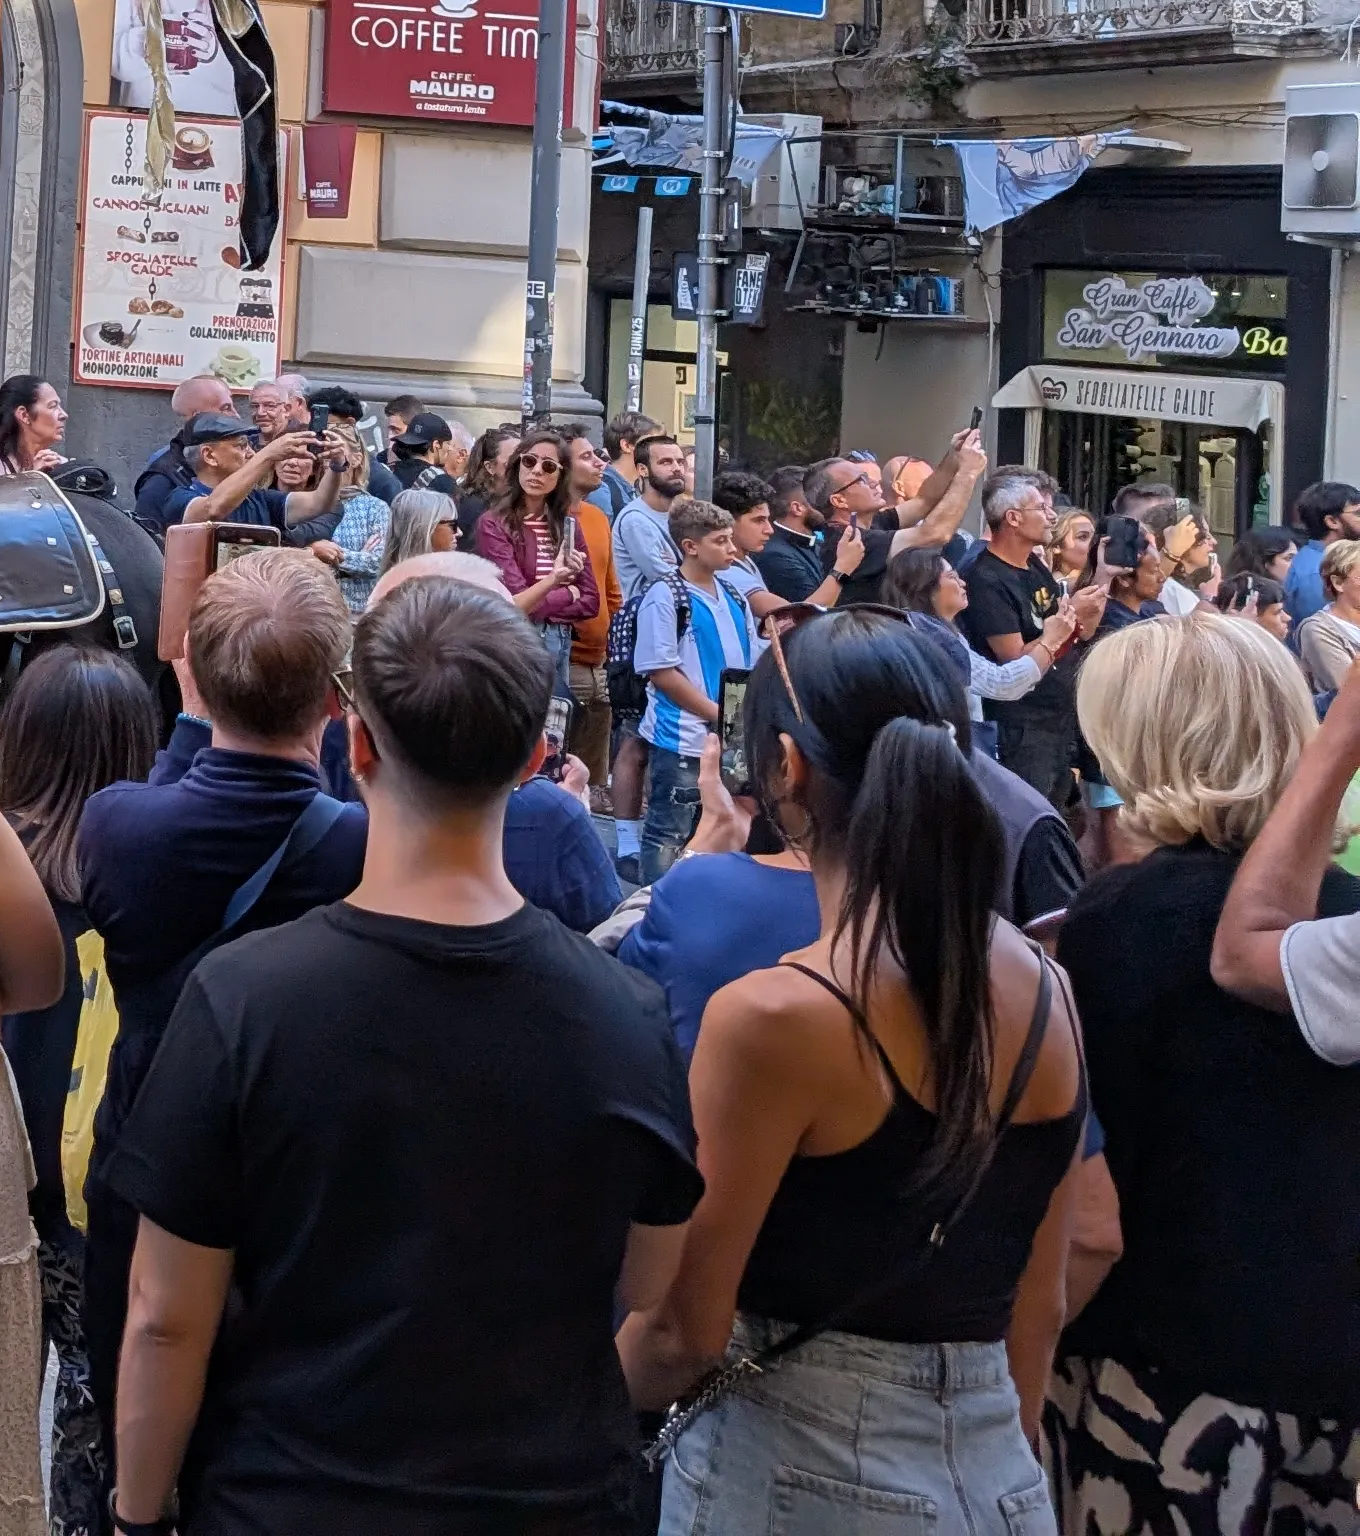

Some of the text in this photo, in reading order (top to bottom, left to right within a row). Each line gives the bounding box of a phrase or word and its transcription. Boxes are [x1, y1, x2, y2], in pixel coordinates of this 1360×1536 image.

[352, 17, 540, 59] COFFEE TIM
[410, 79, 495, 100] MAURO
[424, 102, 463, 113] tostatura
[464, 104, 486, 115] lenta
[111, 175, 221, 192] CAPPUNI IN LATTE
[106, 251, 197, 267] SFOGLIATELLE
[131, 264, 173, 277] CALDE
[736, 270, 763, 289] FANE
[1086, 283, 1199, 318] Gran Caffè
[213, 315, 276, 330] PRENOTAZIONI
[189, 326, 239, 341] COLAZIONE
[251, 331, 276, 344] LETTO
[630, 317, 643, 356] FUNK25
[1059, 311, 1224, 358] San Gennaro
[1242, 326, 1288, 357] Ba
[82, 348, 184, 367] TORTINE ARTIGIANALI
[83, 362, 159, 378] MONOPORZIONE
[1076, 379, 1167, 412] SFOGLIATELLE
[1173, 387, 1215, 417] CALDE
